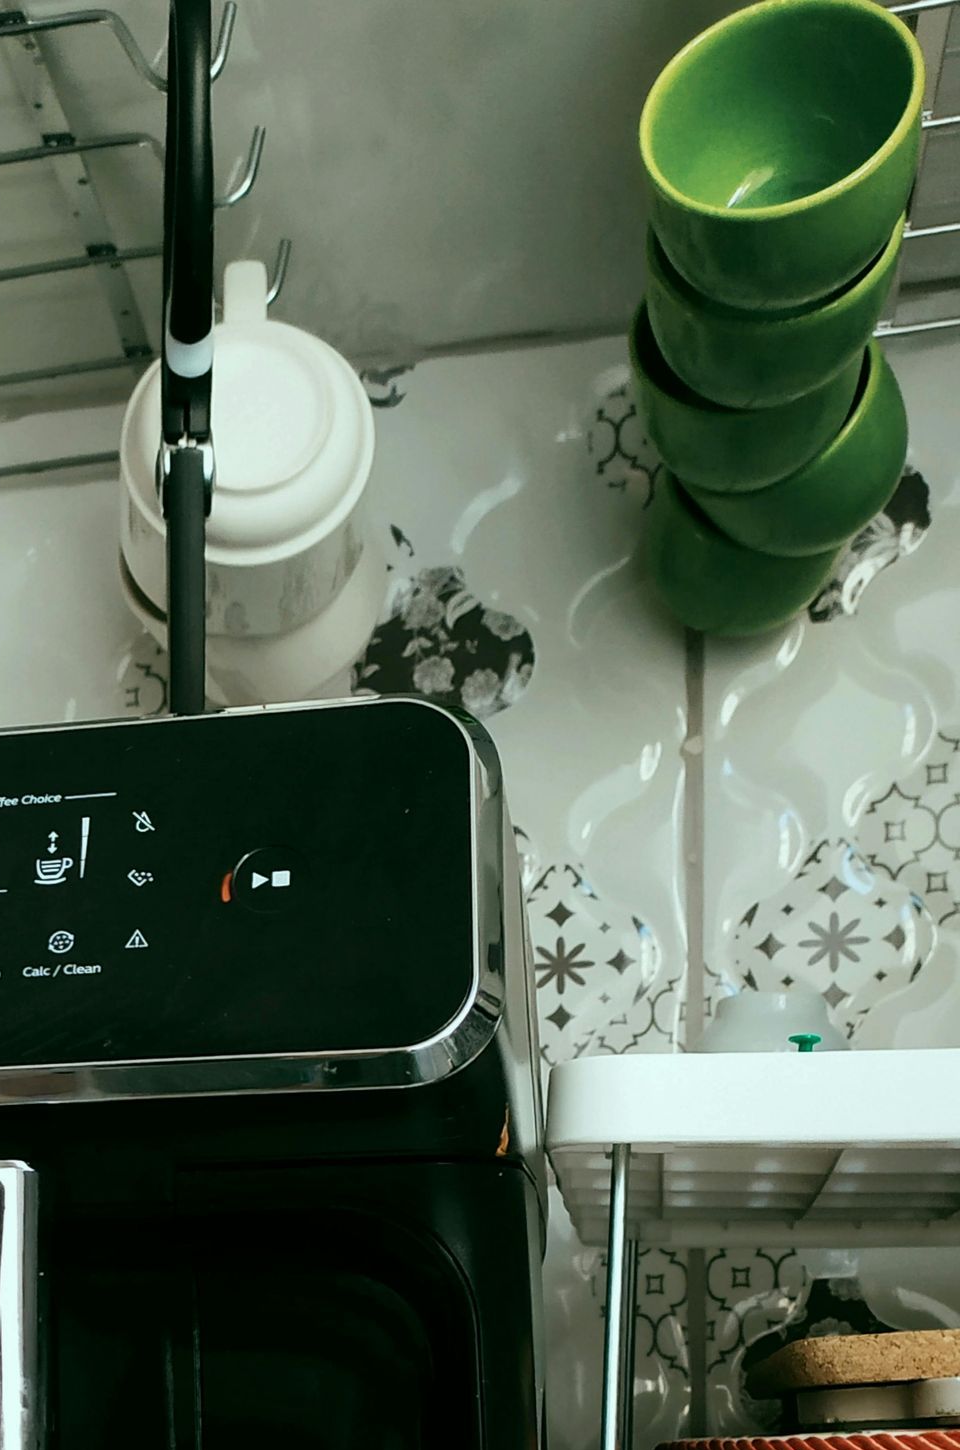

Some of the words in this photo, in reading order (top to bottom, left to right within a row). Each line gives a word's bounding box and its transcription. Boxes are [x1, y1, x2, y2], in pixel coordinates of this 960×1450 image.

[21, 793, 62, 805] Choice
[22, 966, 51, 977] Calc
[52, 964, 62, 977] /
[63, 963, 102, 975] Clean
